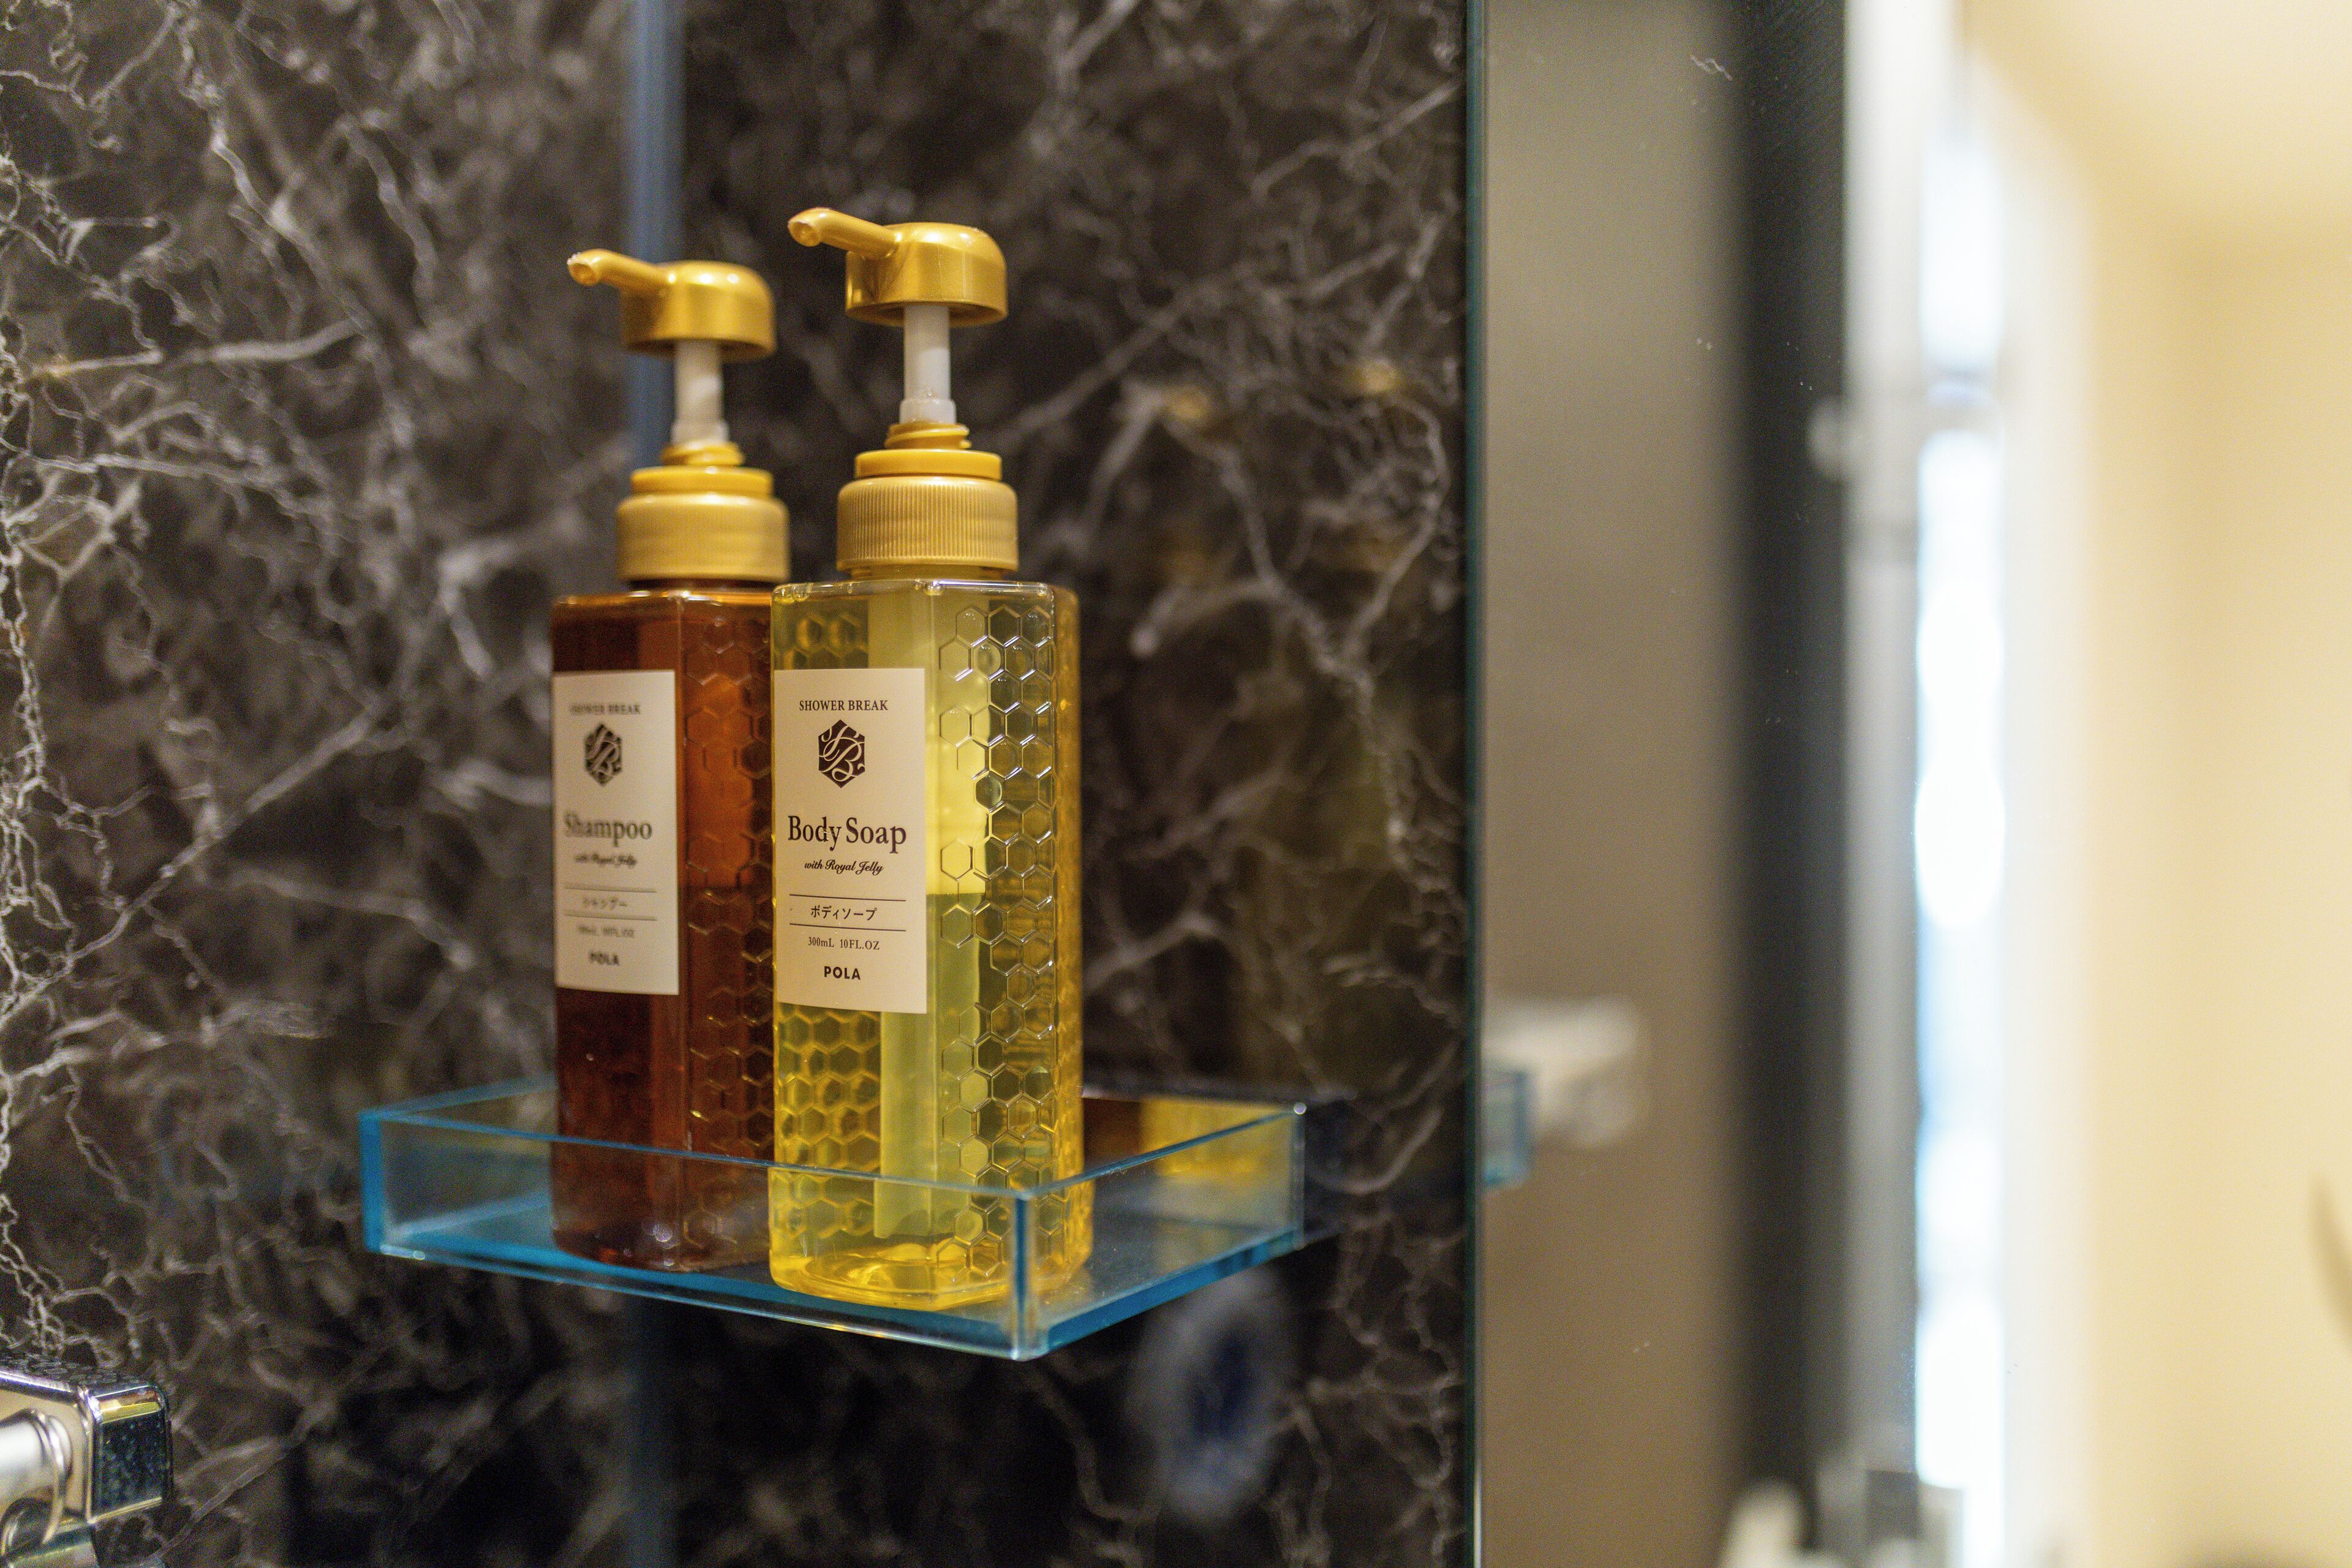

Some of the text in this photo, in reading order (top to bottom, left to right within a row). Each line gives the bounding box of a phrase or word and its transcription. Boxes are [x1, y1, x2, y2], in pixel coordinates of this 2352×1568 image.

[799, 699, 889, 711] SHOWER BREAK
[564, 810, 652, 847] Shampoo
[788, 815, 907, 854] Body Soap
[804, 859, 884, 876] with Royal Jelly
[810, 905, 878, 921] ボディソープ
[808, 937, 880, 950] 300mL 10FL.OZ
[589, 951, 620, 967] POLA
[824, 965, 861, 980] POLA
